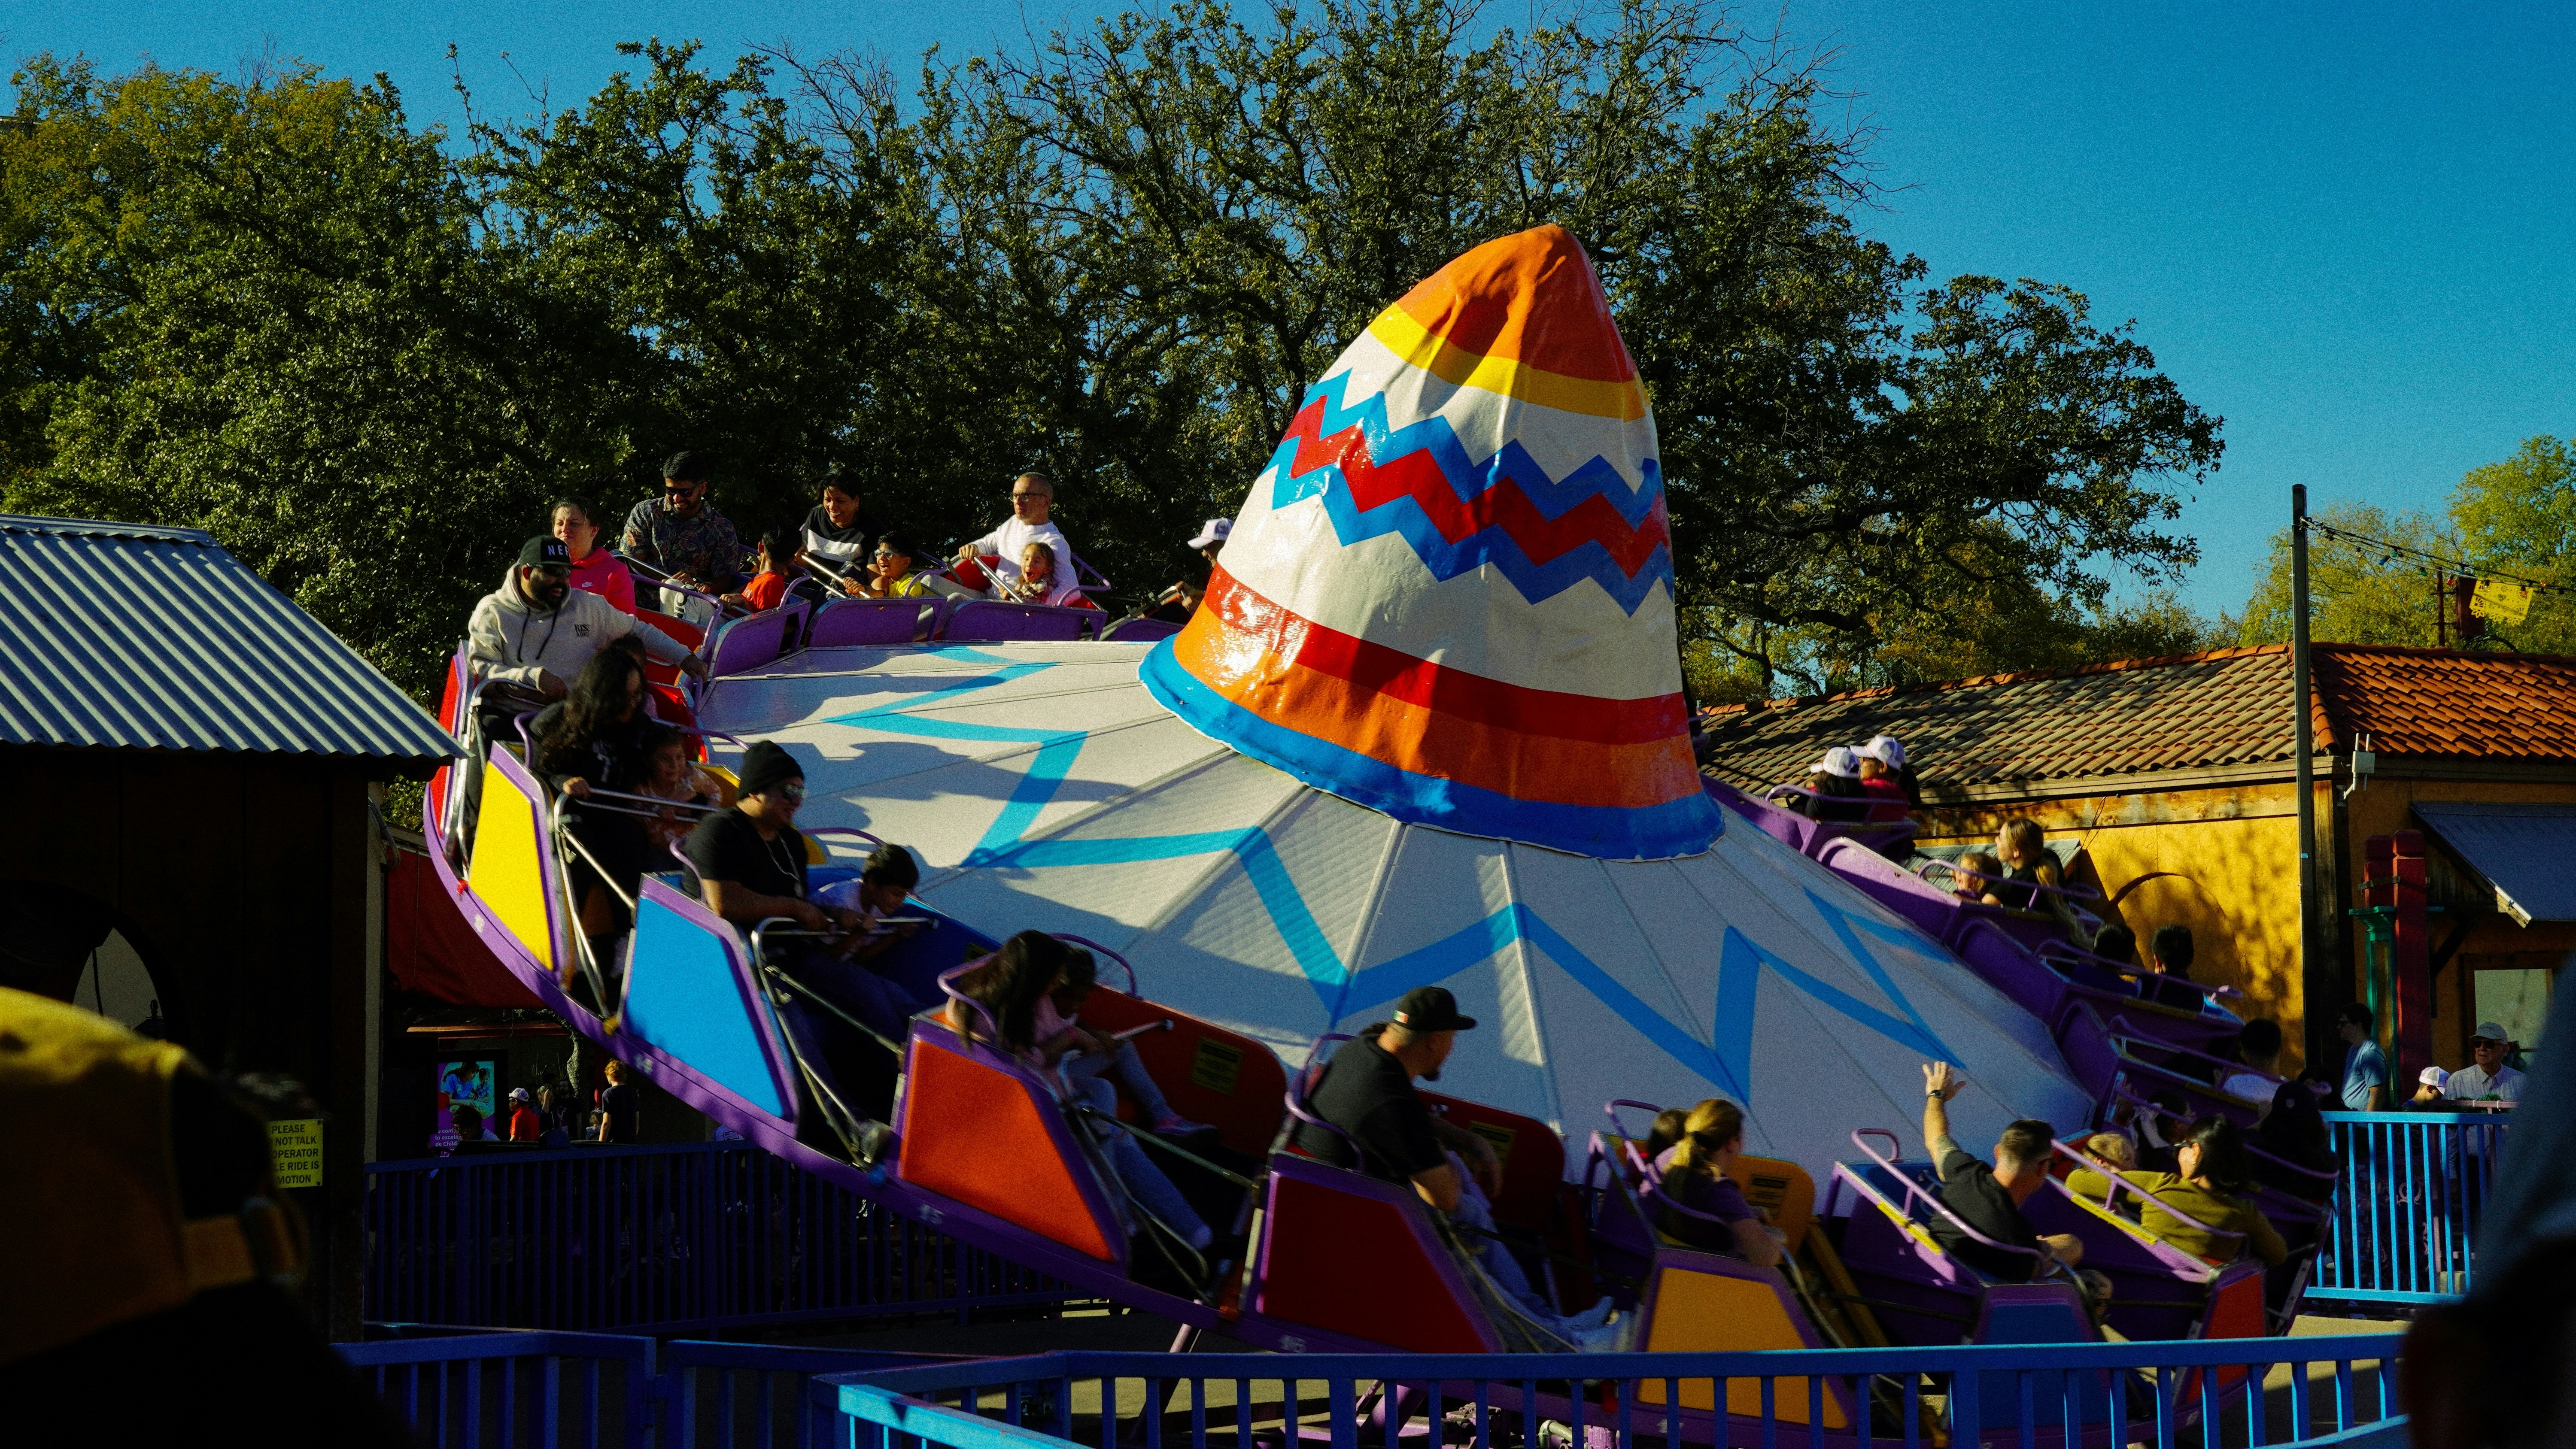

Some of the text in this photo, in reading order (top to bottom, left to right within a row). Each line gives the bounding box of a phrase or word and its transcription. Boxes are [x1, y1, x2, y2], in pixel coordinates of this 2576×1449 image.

[272, 1124, 305, 1134] PLEASE
[276, 1136, 316, 1146] NOT TALK
[288, 1161, 308, 1171] RIDE
[311, 1161, 319, 1170] IS
